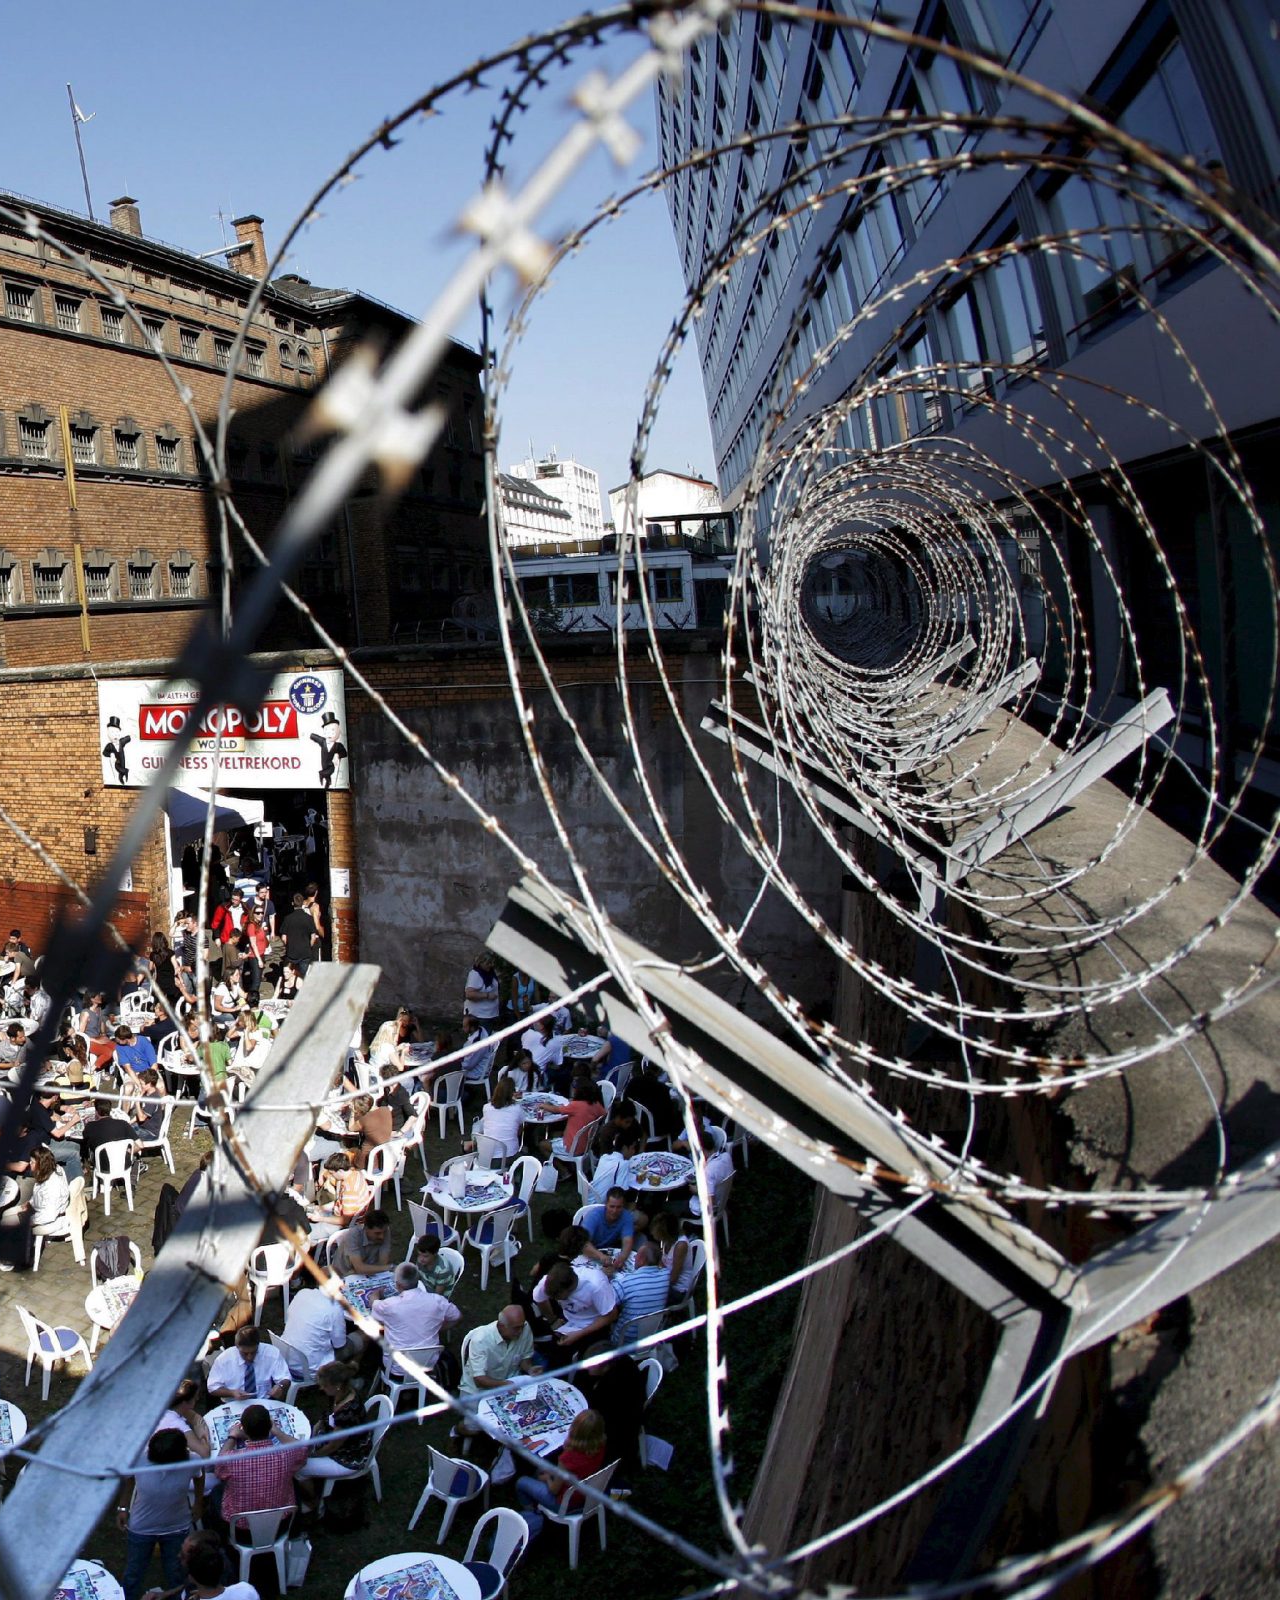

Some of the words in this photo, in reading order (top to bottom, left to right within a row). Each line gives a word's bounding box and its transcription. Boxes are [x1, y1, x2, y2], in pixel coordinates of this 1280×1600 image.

[145, 707, 291, 734] MOOPOLY
[197, 740, 237, 749] WORLD
[142, 757, 208, 769] GUINESS
